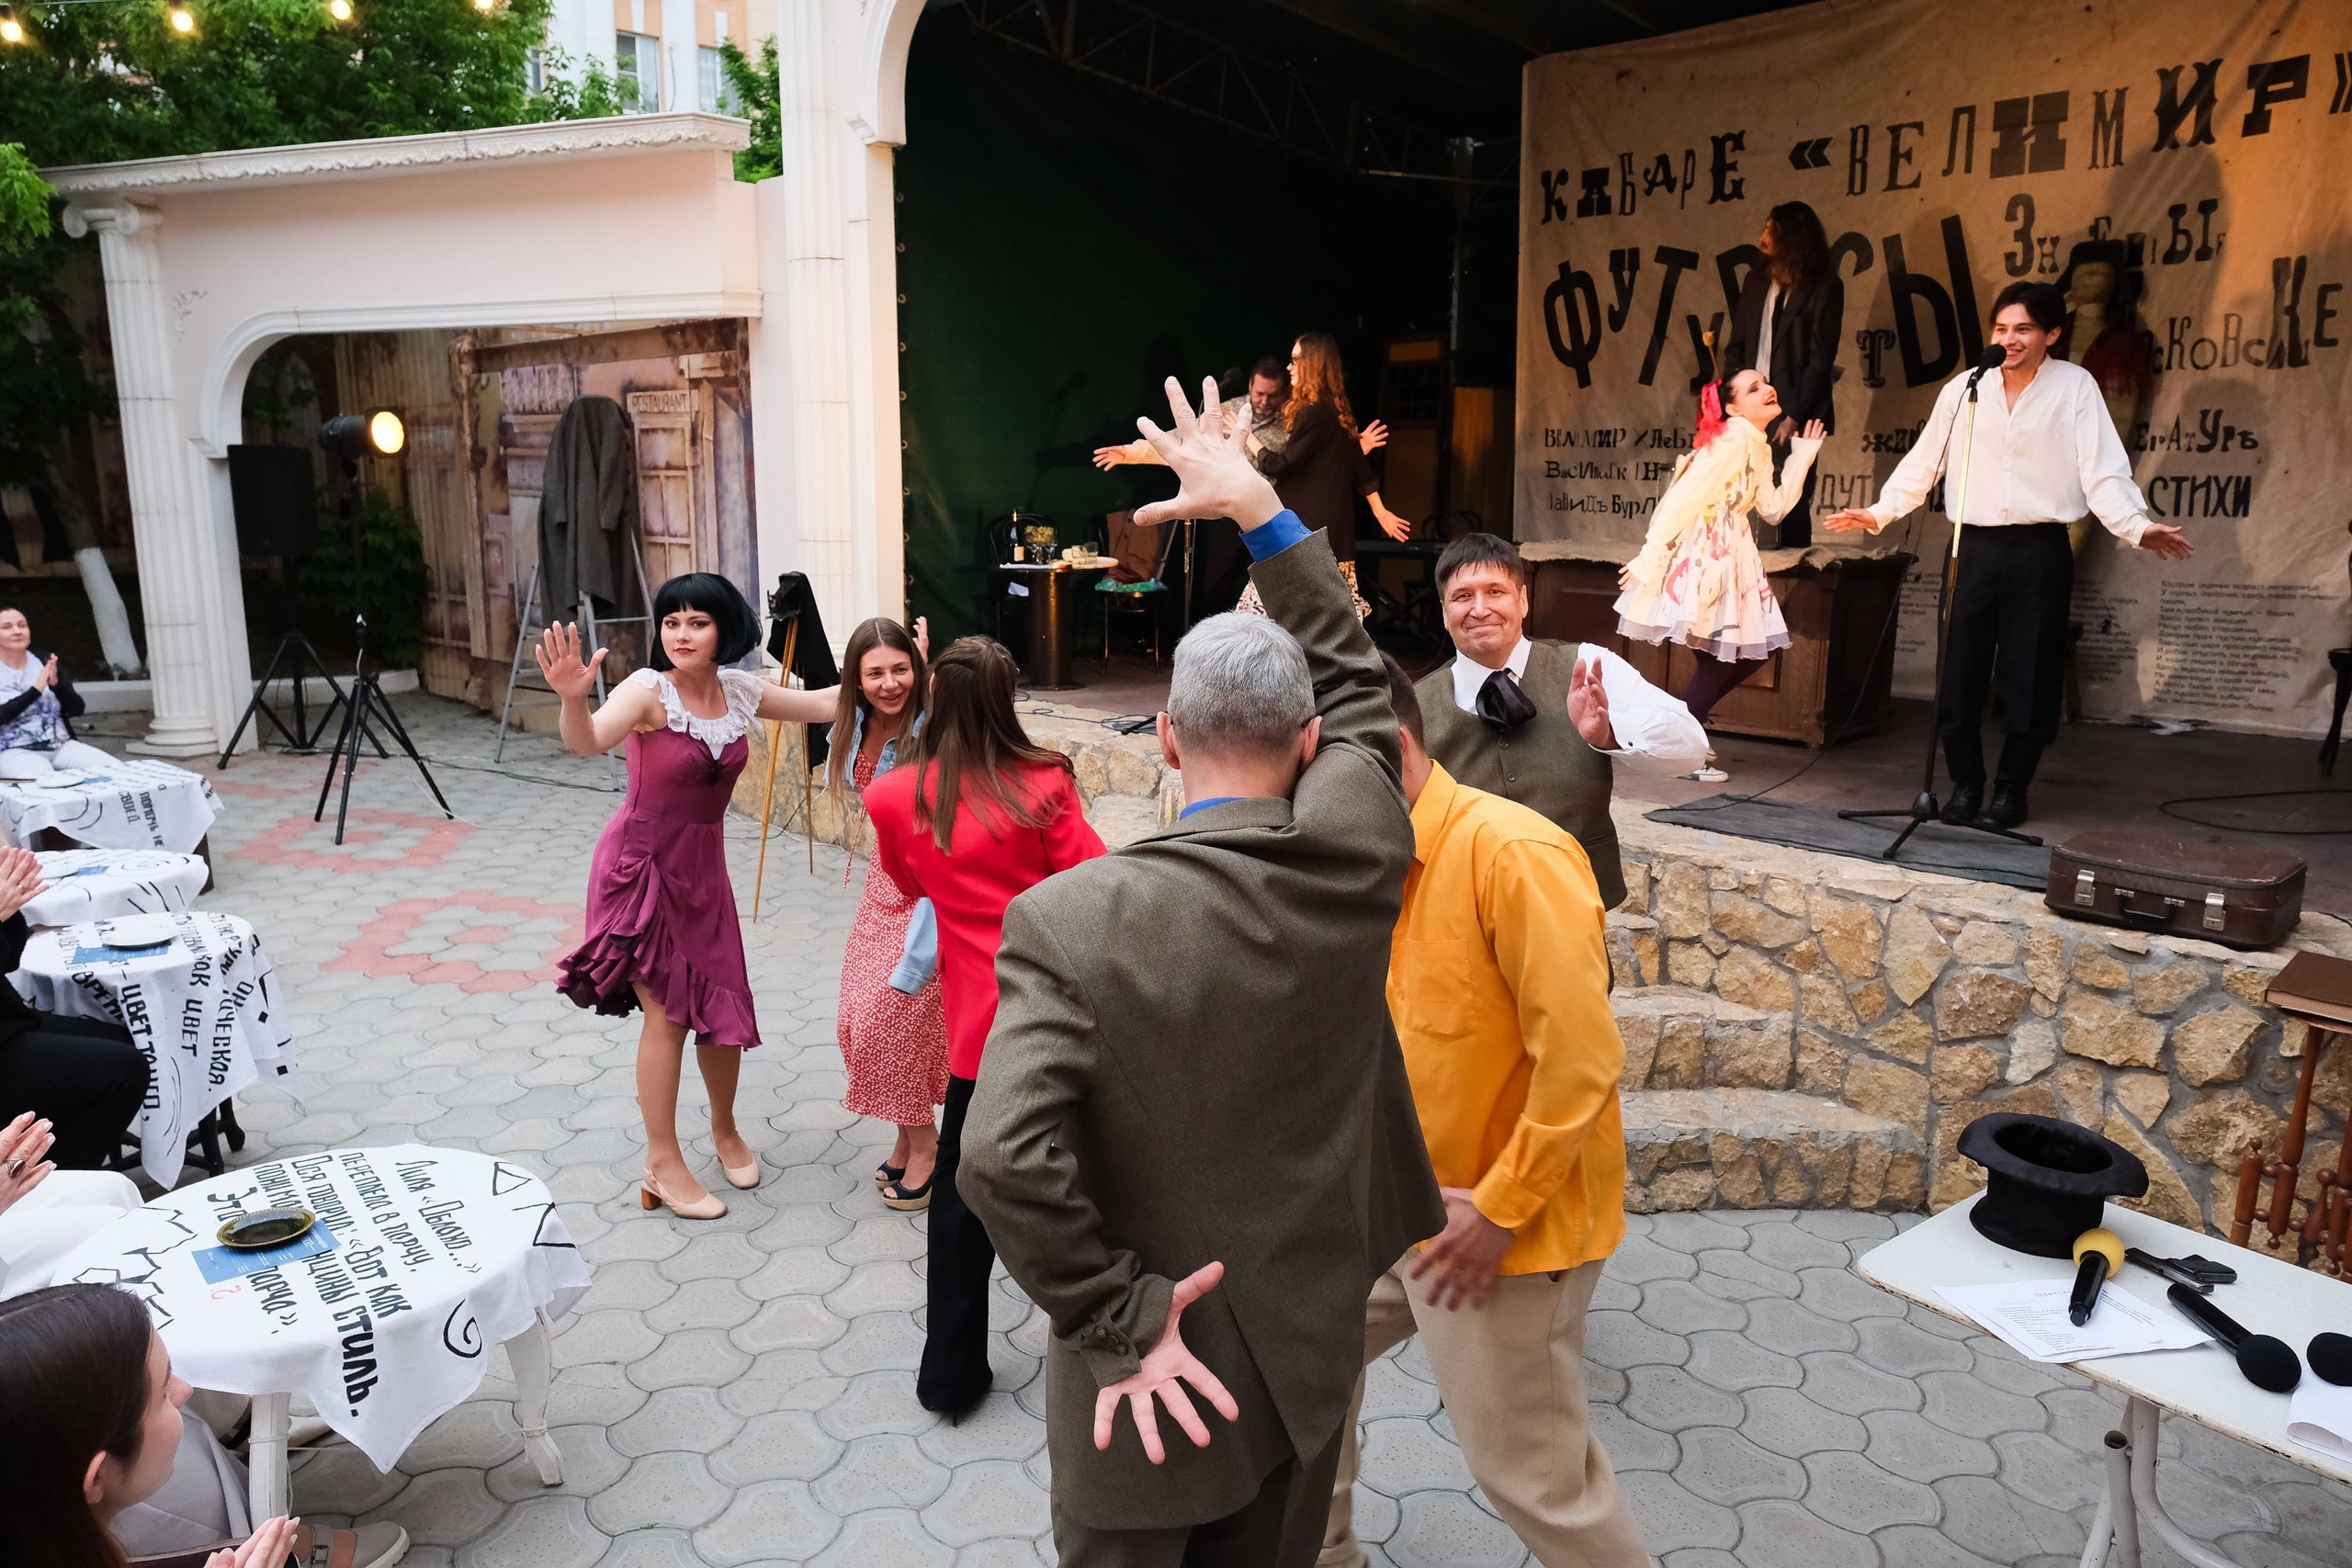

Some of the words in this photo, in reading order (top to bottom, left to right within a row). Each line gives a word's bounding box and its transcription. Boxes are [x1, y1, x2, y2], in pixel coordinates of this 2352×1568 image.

[1542, 130, 1746, 225] КАБАРЕ
[1543, 214, 1985, 396] ФУТУРСТЫ
[2148, 475, 2252, 518] СТИХИ
[181, 998, 203, 1057] ЦВЕТ
